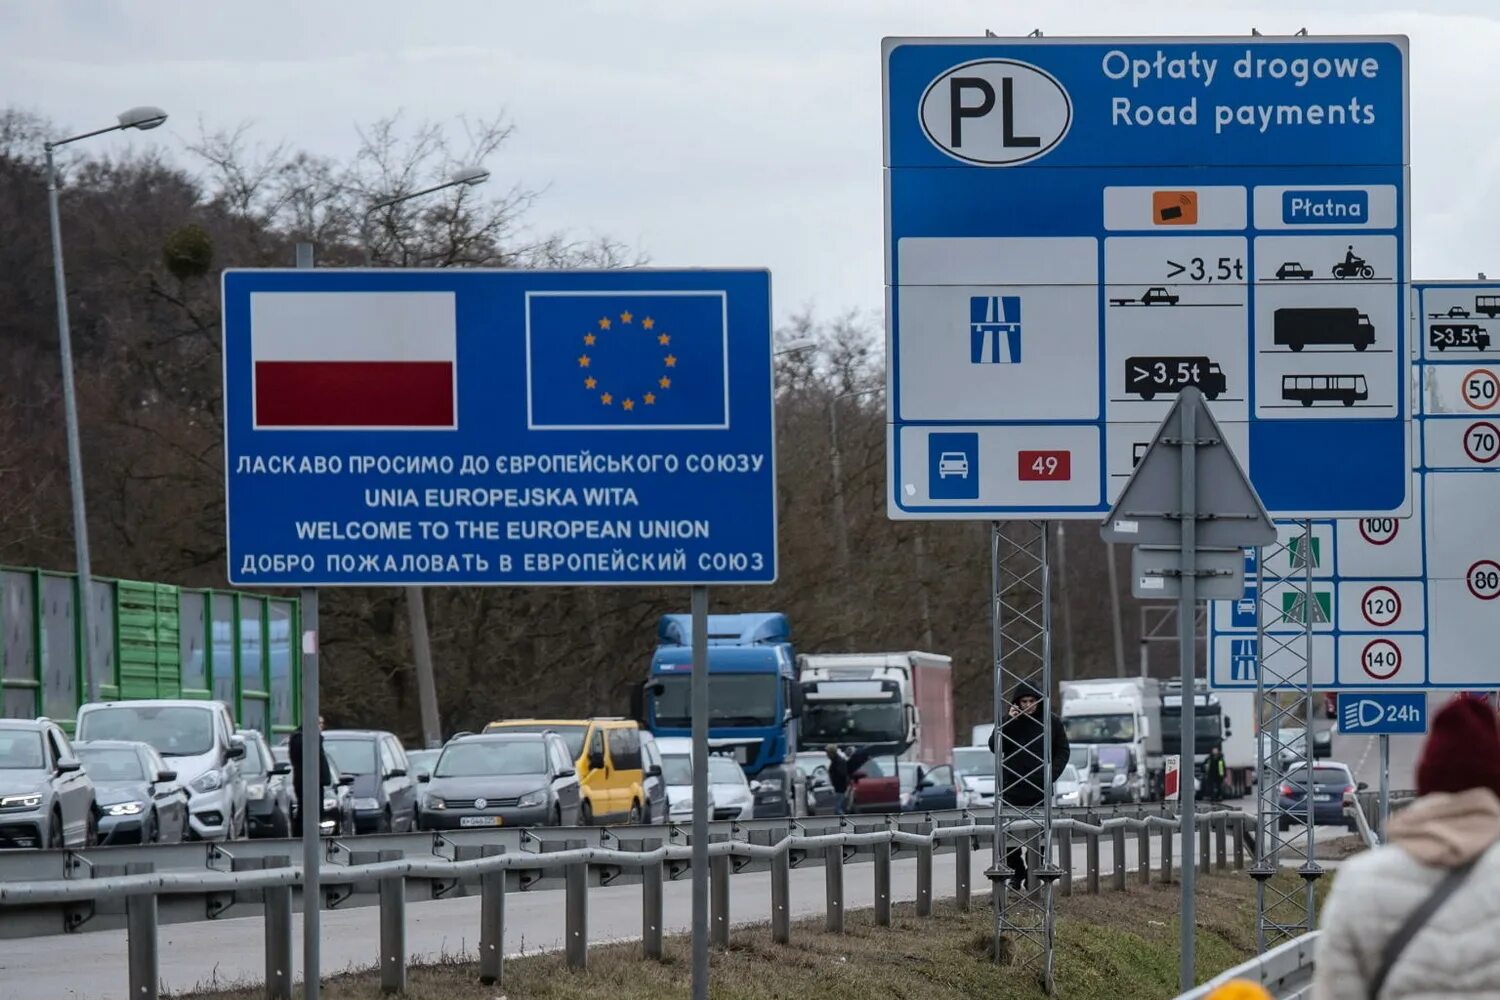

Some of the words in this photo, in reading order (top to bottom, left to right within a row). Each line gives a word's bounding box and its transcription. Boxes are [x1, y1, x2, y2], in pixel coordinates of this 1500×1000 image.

[1102, 49, 1218, 88] Opłaty
[1233, 49, 1379, 87] drogowe
[949, 76, 1041, 148] PL
[1112, 96, 1197, 126] Road
[1215, 96, 1376, 134] payments
[1291, 198, 1361, 217] Płatna
[1468, 379, 1496, 400] 50
[1472, 432, 1497, 453] 70
[236, 455, 343, 474] ЛАСКАВО
[349, 455, 454, 474] ПРОСИМО
[459, 455, 490, 476] ДО
[495, 450, 679, 474] ЄВРОПЕЙСЬКОГО
[685, 453, 764, 473] СОЮЗУ
[1031, 457, 1058, 476] 49
[365, 488, 420, 508] UNIA
[425, 487, 579, 508] EUROPEJSKA
[582, 487, 639, 506] WITA
[295, 521, 412, 540] WELCOME
[418, 520, 449, 540] TO
[454, 520, 500, 540] THE
[506, 520, 632, 540] EUROPEAN
[638, 519, 710, 539] UNION
[1364, 519, 1394, 534] 100
[240, 554, 315, 575] ДОБРО
[326, 553, 489, 573] ПОЖАЛОВАТЬ
[499, 554, 513, 573] В
[523, 548, 686, 572] ЕВРОПЕЙСКИЙ
[698, 552, 764, 571] СОЮЗ
[1473, 569, 1500, 591] 80
[1365, 596, 1397, 616] 120
[1365, 649, 1397, 669] 140
[1386, 704, 1420, 722] 24h
